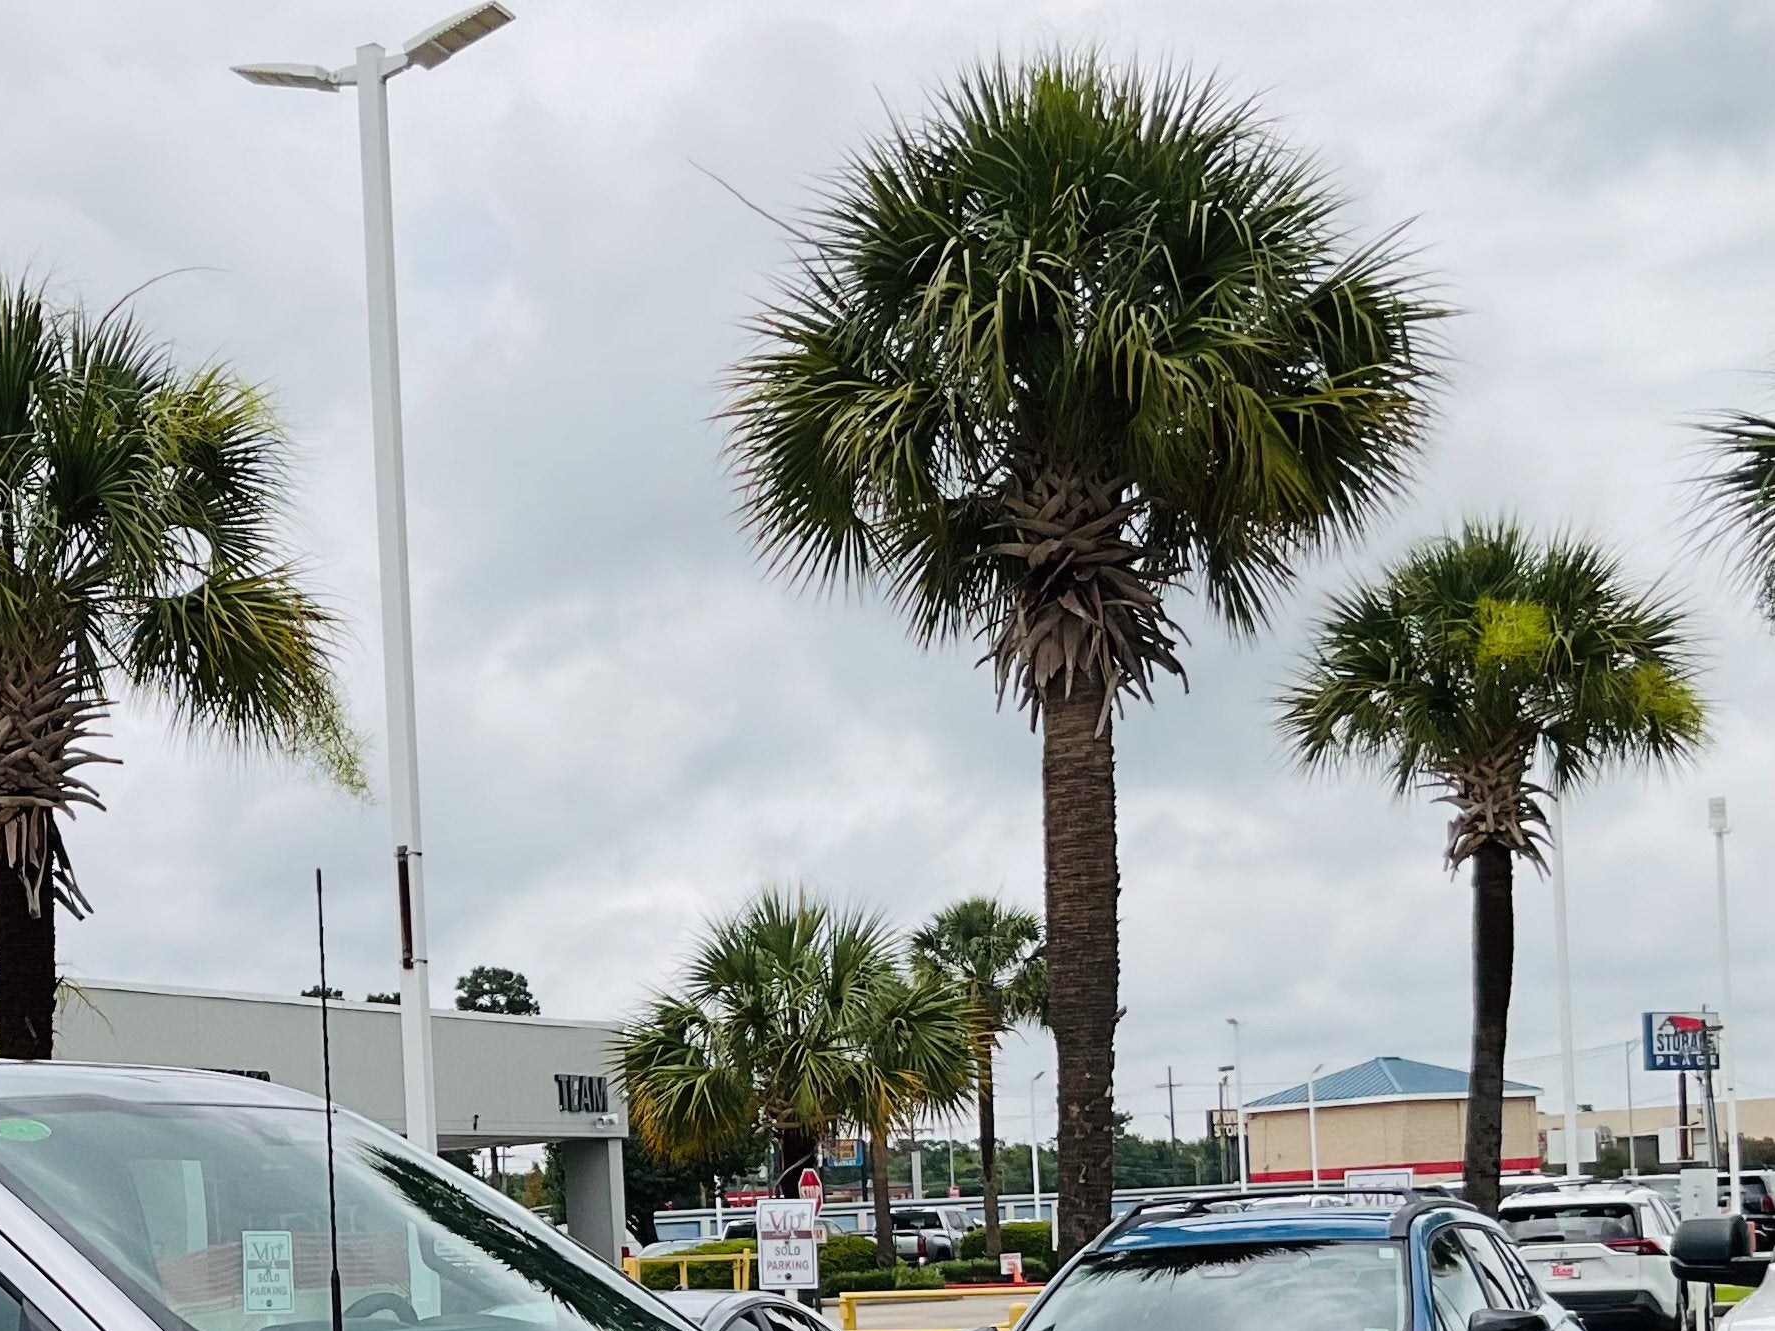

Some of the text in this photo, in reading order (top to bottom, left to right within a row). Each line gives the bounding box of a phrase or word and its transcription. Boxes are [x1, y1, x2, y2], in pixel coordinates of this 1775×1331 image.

[1655, 1055, 1718, 1066] PLACE
[553, 1074, 609, 1113] TEAM
[800, 1185, 821, 1199] STOP
[774, 1245, 801, 1256] SOLD
[766, 1260, 809, 1271] PARKING
[257, 1273, 281, 1283] SOLD
[250, 1286, 288, 1296] PARKING
